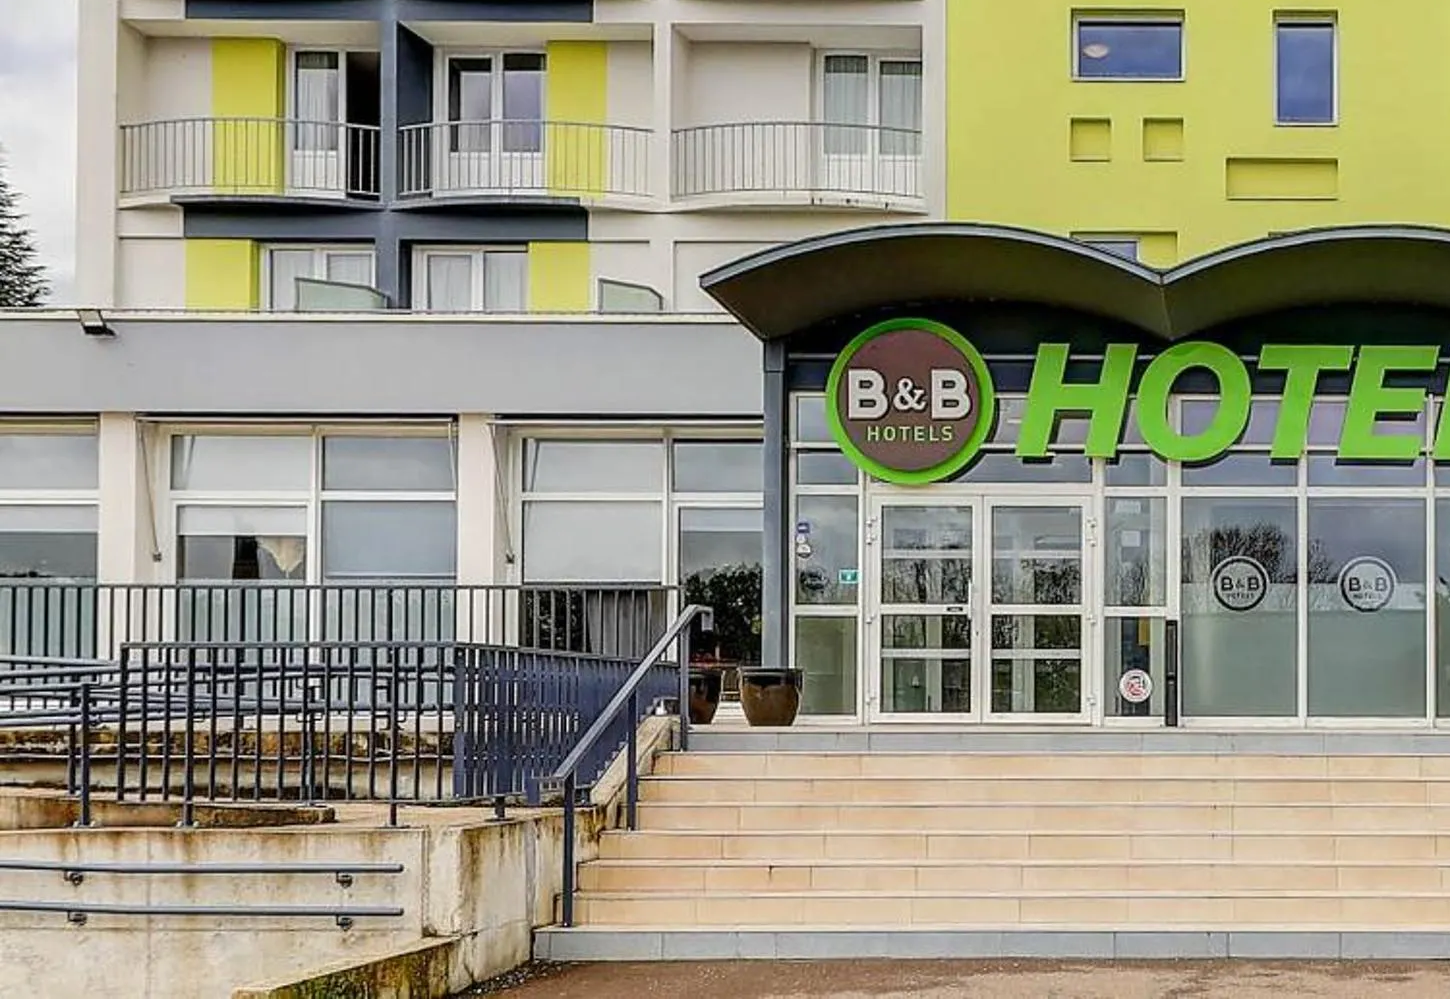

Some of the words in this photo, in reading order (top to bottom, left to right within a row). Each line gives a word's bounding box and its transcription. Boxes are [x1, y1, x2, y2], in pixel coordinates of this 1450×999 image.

[848, 369, 971, 420] B&B
[867, 426, 953, 442] HOTELS
[1221, 576, 1260, 592] B&B
[1348, 576, 1388, 592] B&B
